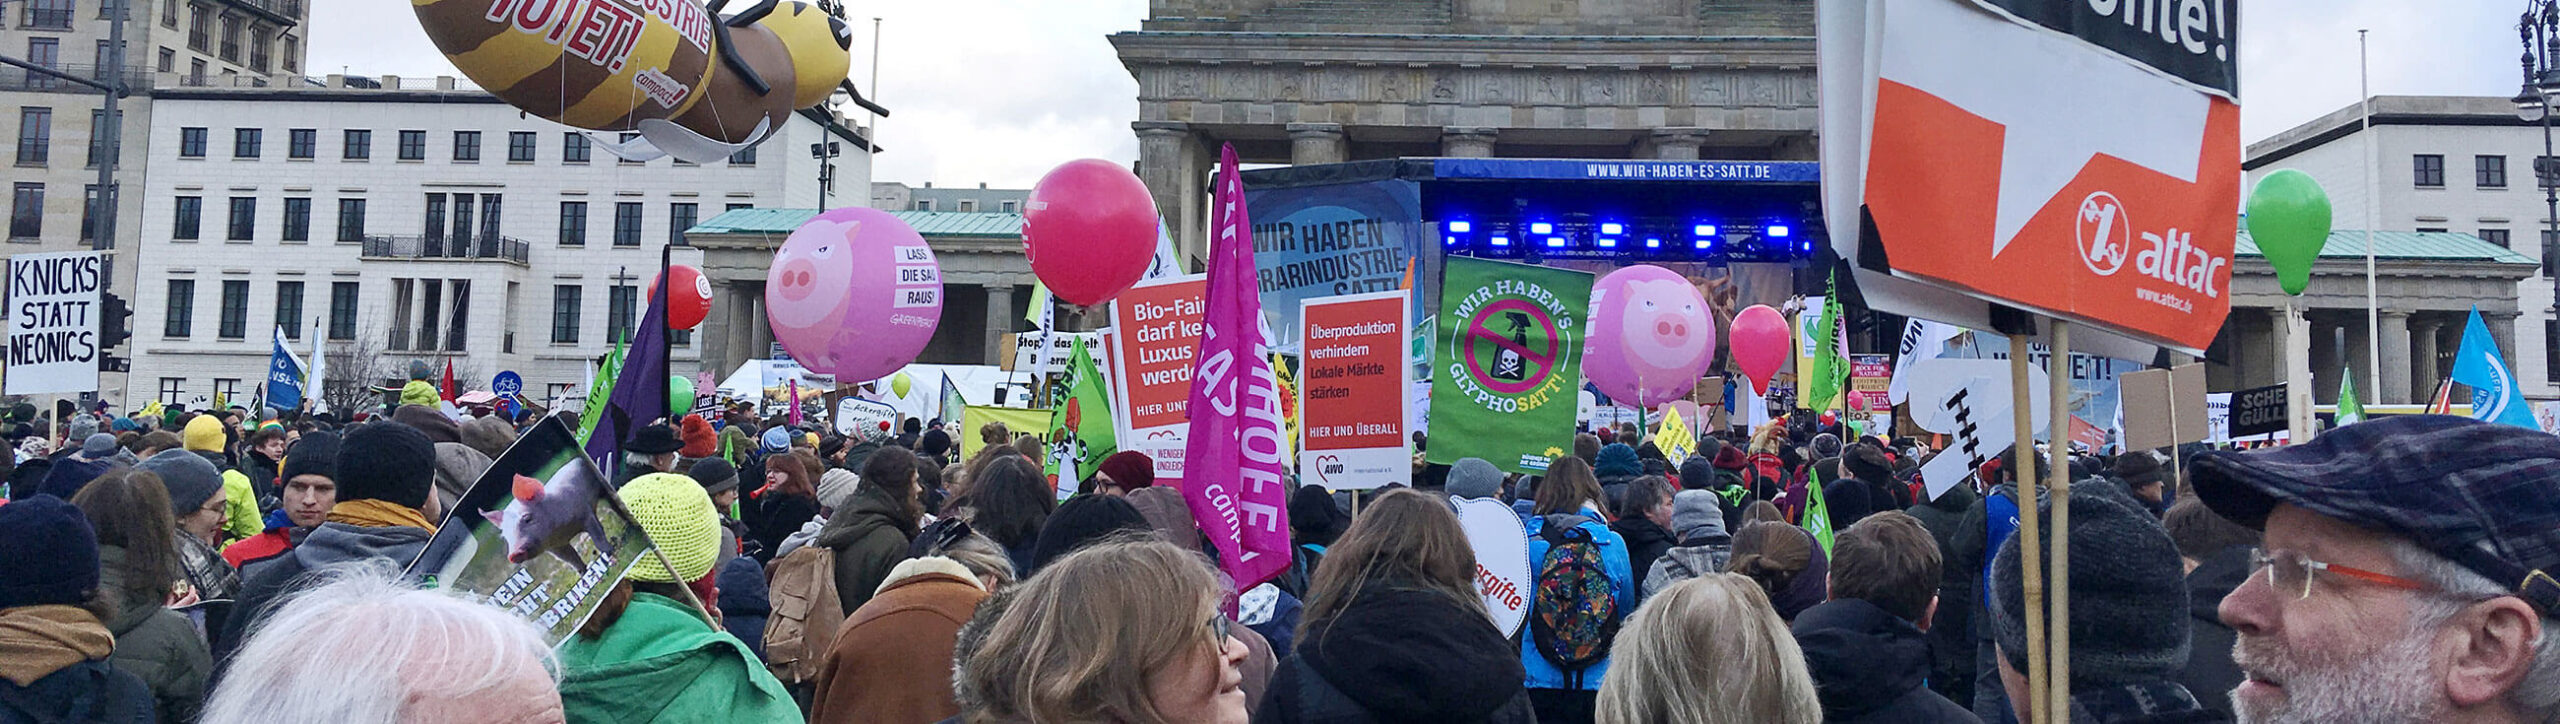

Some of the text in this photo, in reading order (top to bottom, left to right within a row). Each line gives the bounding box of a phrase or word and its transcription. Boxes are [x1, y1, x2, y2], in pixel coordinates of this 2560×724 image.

[636, 73, 687, 106] campact!
[1587, 164, 1770, 178] WWW.WIR-HABEN-ES-SATT.DE
[1252, 217, 1384, 254] WIR HABEN
[2136, 228, 2226, 299] attac
[14, 256, 99, 298] KNICKS
[902, 269, 918, 282] DIE
[1454, 279, 1573, 330] WIR HABEN'S
[2136, 287, 2193, 315] www.attac.de
[20, 301, 90, 329] STATT
[1137, 317, 1204, 342] darf ke
[1311, 321, 1396, 342] Überproduktion
[10, 331, 94, 367] NEONICS
[1054, 336, 1072, 348] das
[1310, 345, 1369, 359] verhindern
[1139, 345, 1193, 364] Luxus
[1311, 362, 1384, 379] Lokale Märkte
[1310, 386, 1350, 400] stärken
[1450, 363, 1566, 413] GLYPHOSATT!
[2241, 388, 2286, 409] SCHE
[1137, 404, 1163, 416] HIER
[1310, 421, 1398, 438] HIER UND ÜBERALL
[1324, 463, 1344, 475] AWO
